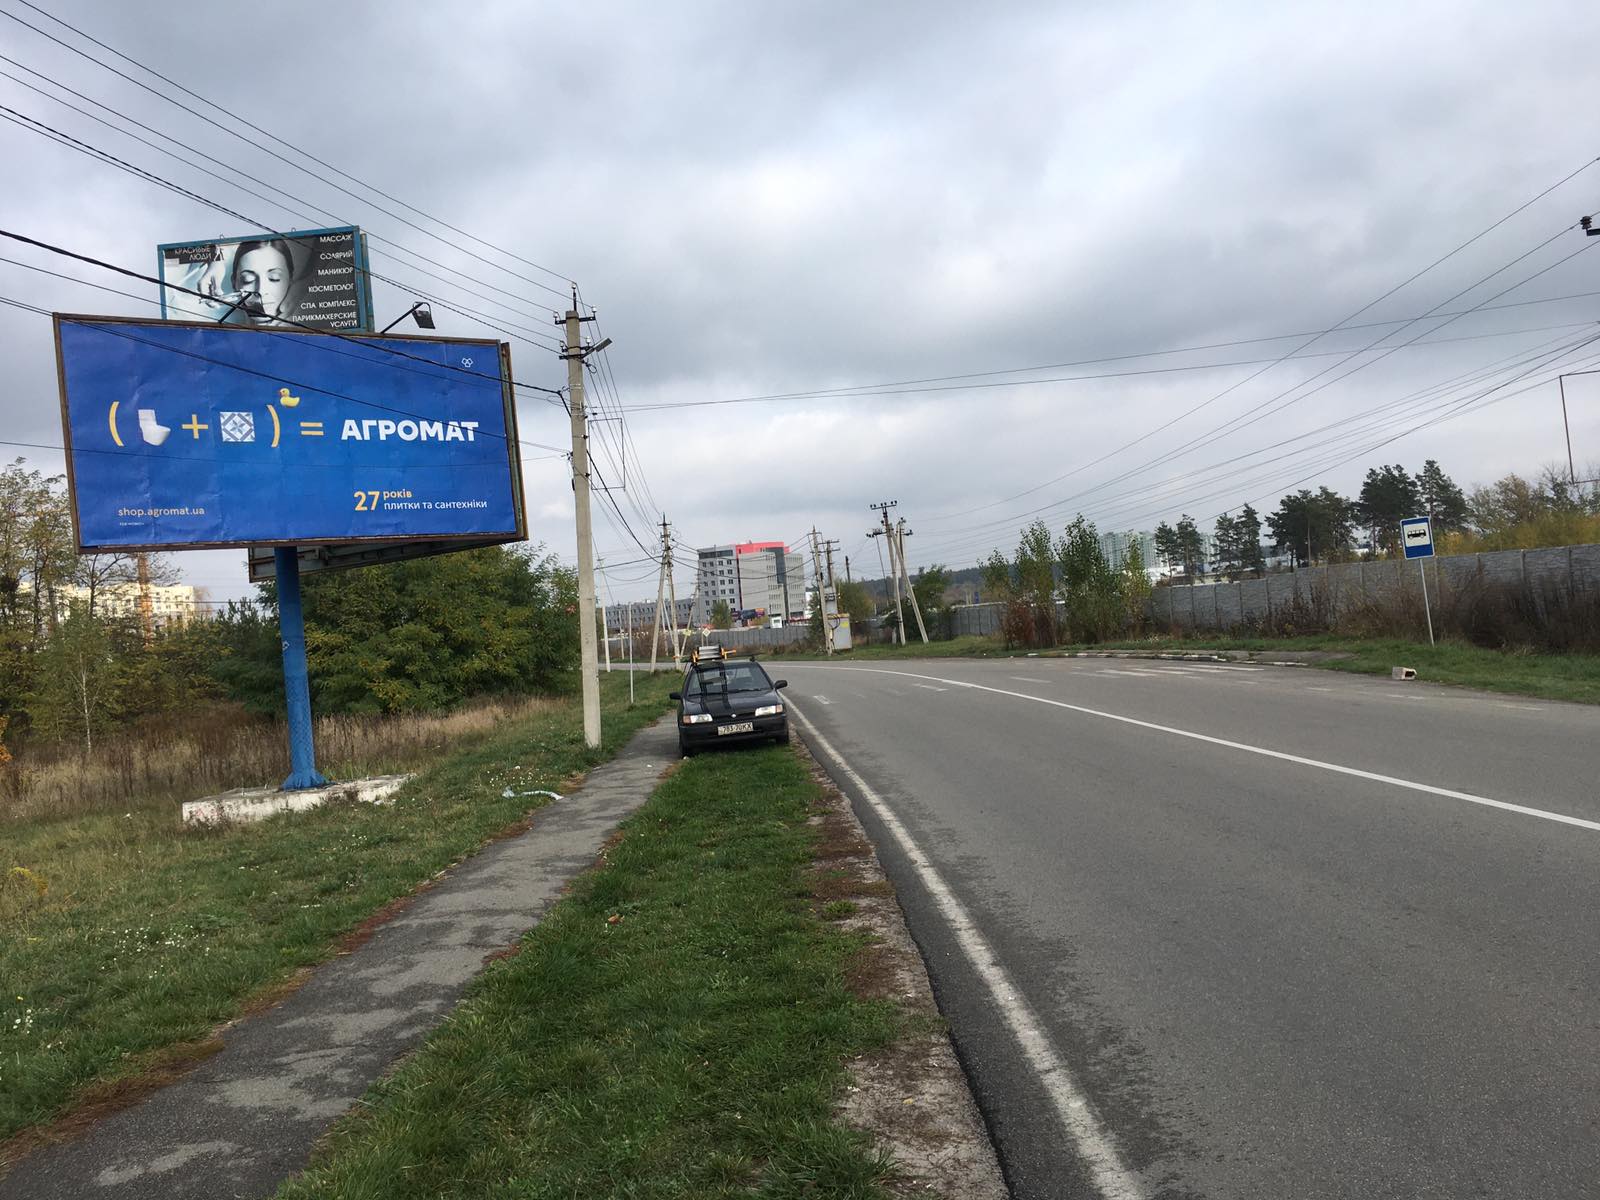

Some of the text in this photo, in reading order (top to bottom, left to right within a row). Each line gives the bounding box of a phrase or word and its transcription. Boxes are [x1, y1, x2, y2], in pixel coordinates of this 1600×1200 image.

[319, 234, 352, 243] МАССАЖ
[189, 253, 212, 261] ЛЮДИ
[319, 249, 353, 260] СОЛЯРИЙ
[317, 266, 354, 276] МАНИКЮР
[308, 282, 354, 293] КОСМЕТОЛОГ
[300, 299, 357, 310] СПА КОМПЛЕКС
[292, 311, 357, 323] ПАРИКМАХЕРСКИЕ
[330, 320, 357, 328] УСЛУГИ
[341, 419, 479, 441] АГРОМАТ
[353, 488, 412, 511] 27 років
[384, 499, 488, 510] плитки та сантехніки
[118, 507, 205, 517] shop.agromat.ua
